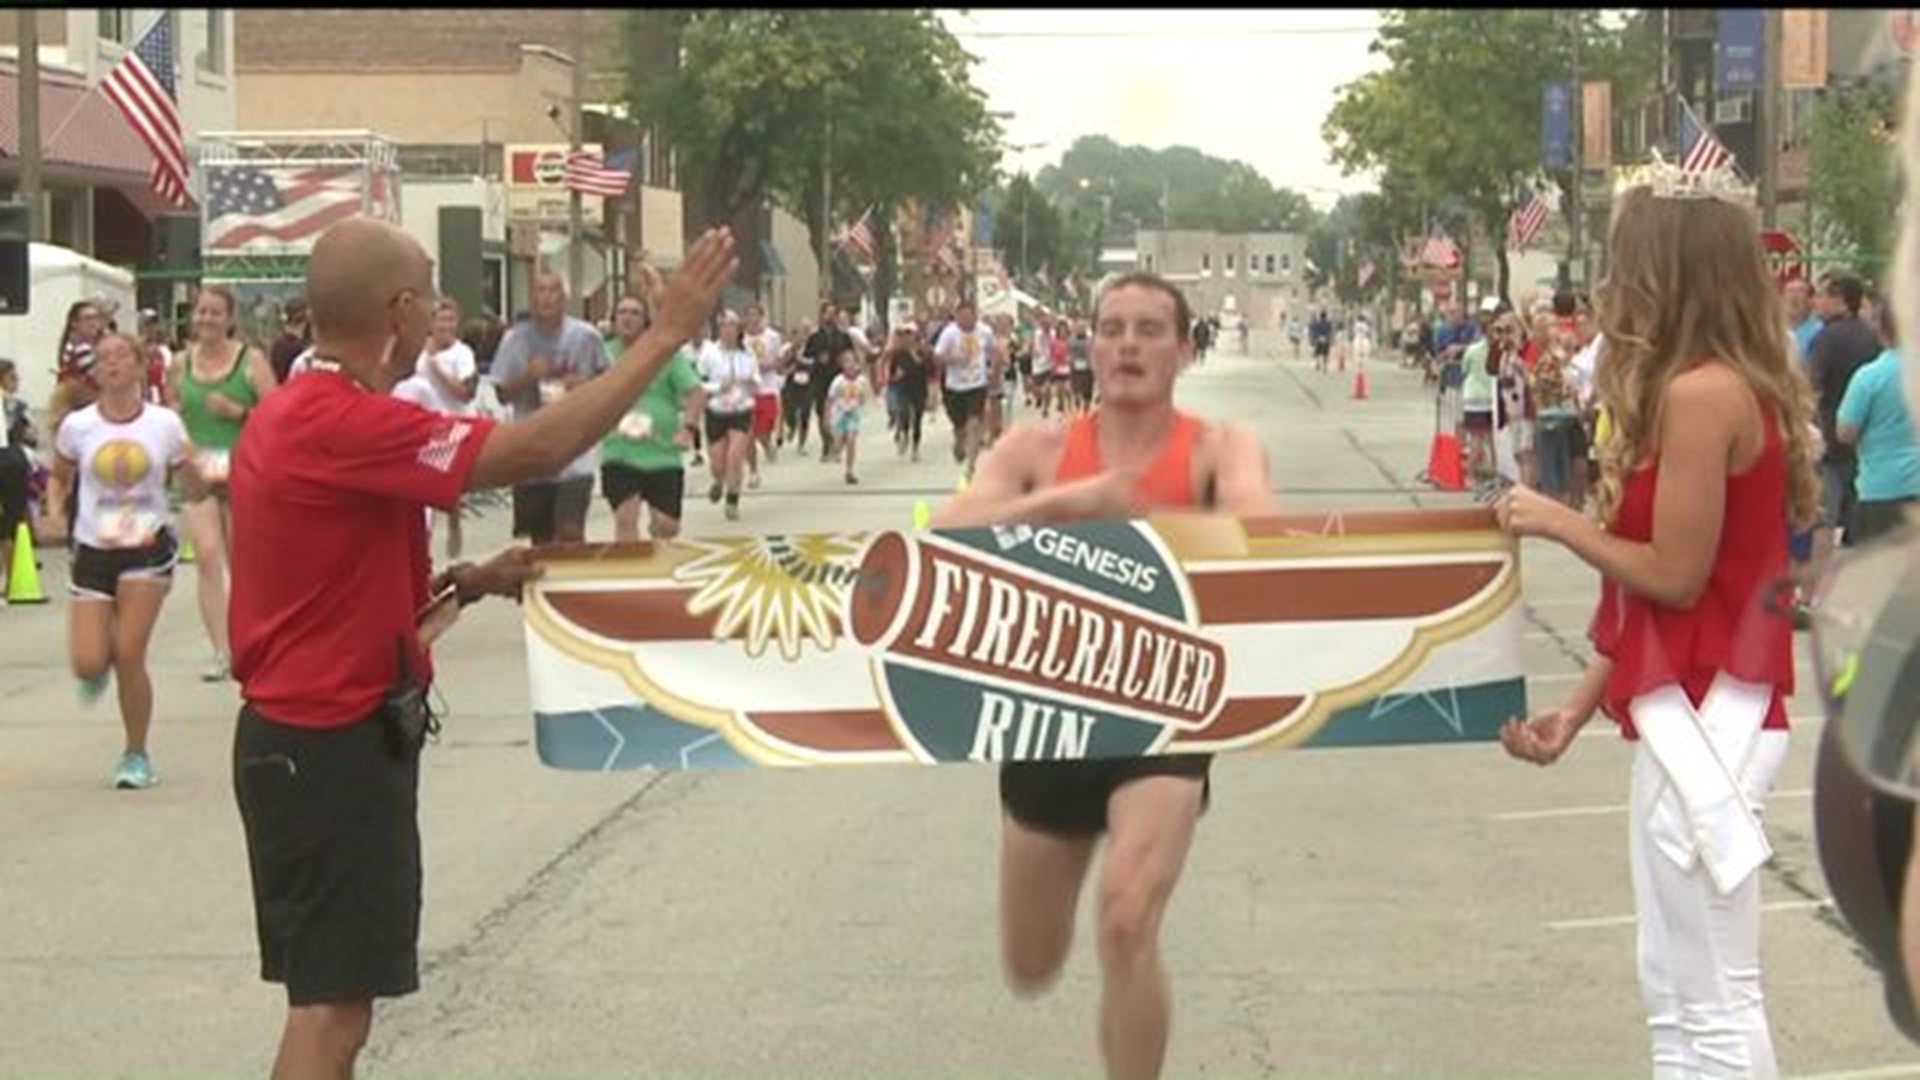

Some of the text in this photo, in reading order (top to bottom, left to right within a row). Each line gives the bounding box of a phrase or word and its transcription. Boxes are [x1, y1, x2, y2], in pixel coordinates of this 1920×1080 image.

[1033, 527, 1159, 593] GENESIS
[914, 557, 1217, 715] FIRECRACKER
[967, 691, 1096, 763] RUN
